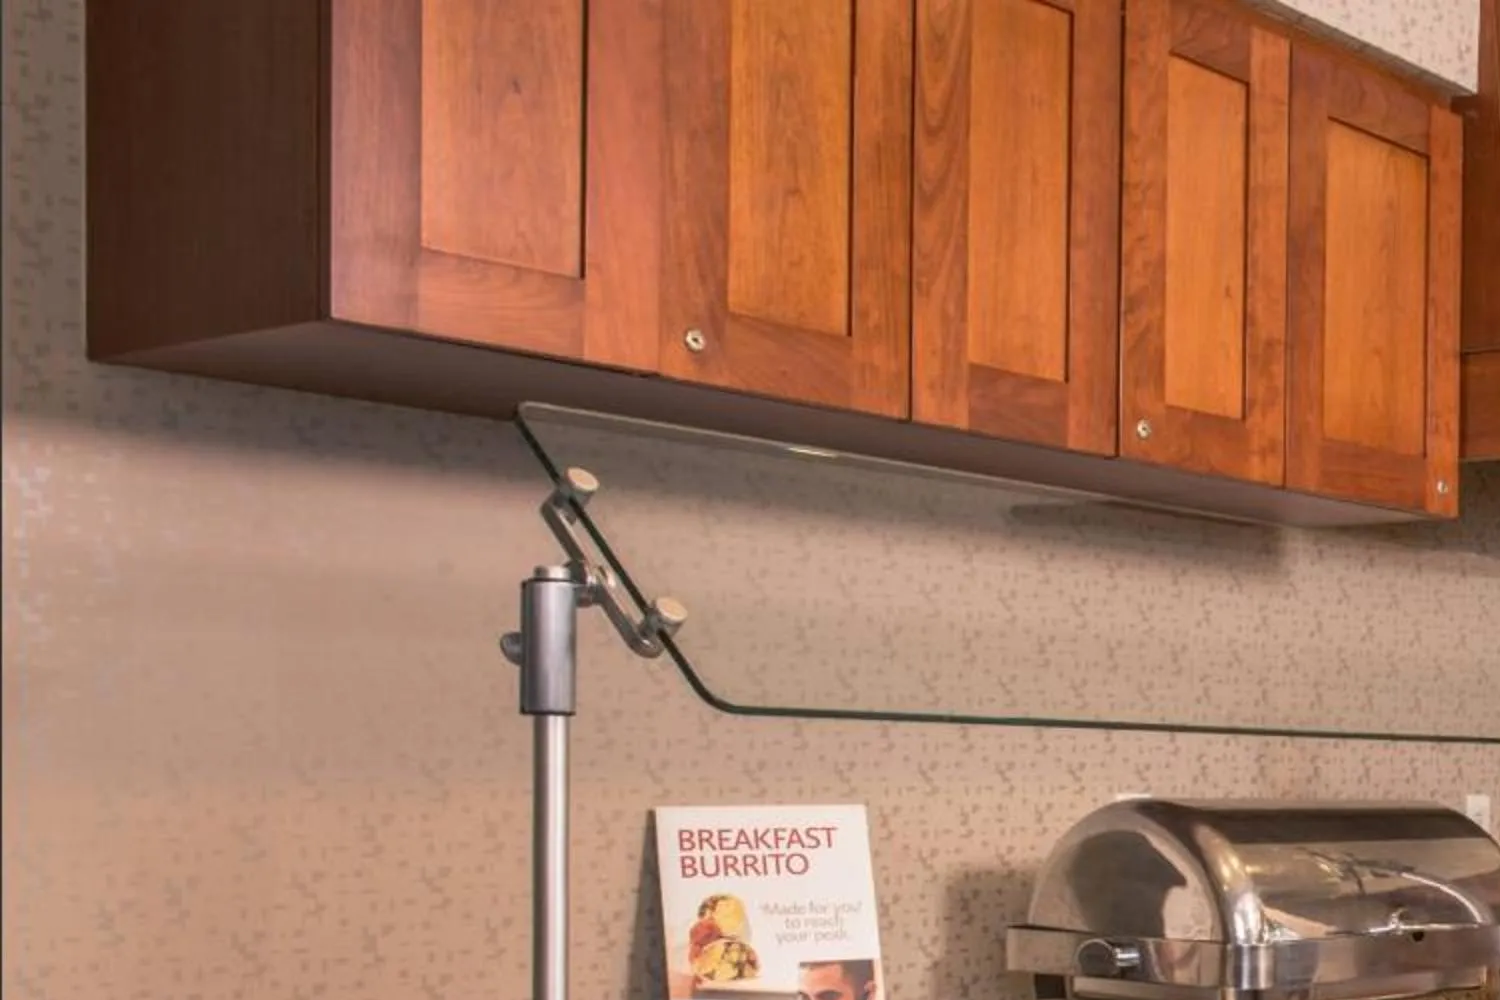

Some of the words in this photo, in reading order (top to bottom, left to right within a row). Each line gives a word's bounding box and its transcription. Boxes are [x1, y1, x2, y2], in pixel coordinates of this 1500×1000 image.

[677, 826, 839, 851] BREAKFAST
[679, 852, 810, 879] BURRITO
[784, 917, 801, 930] to
